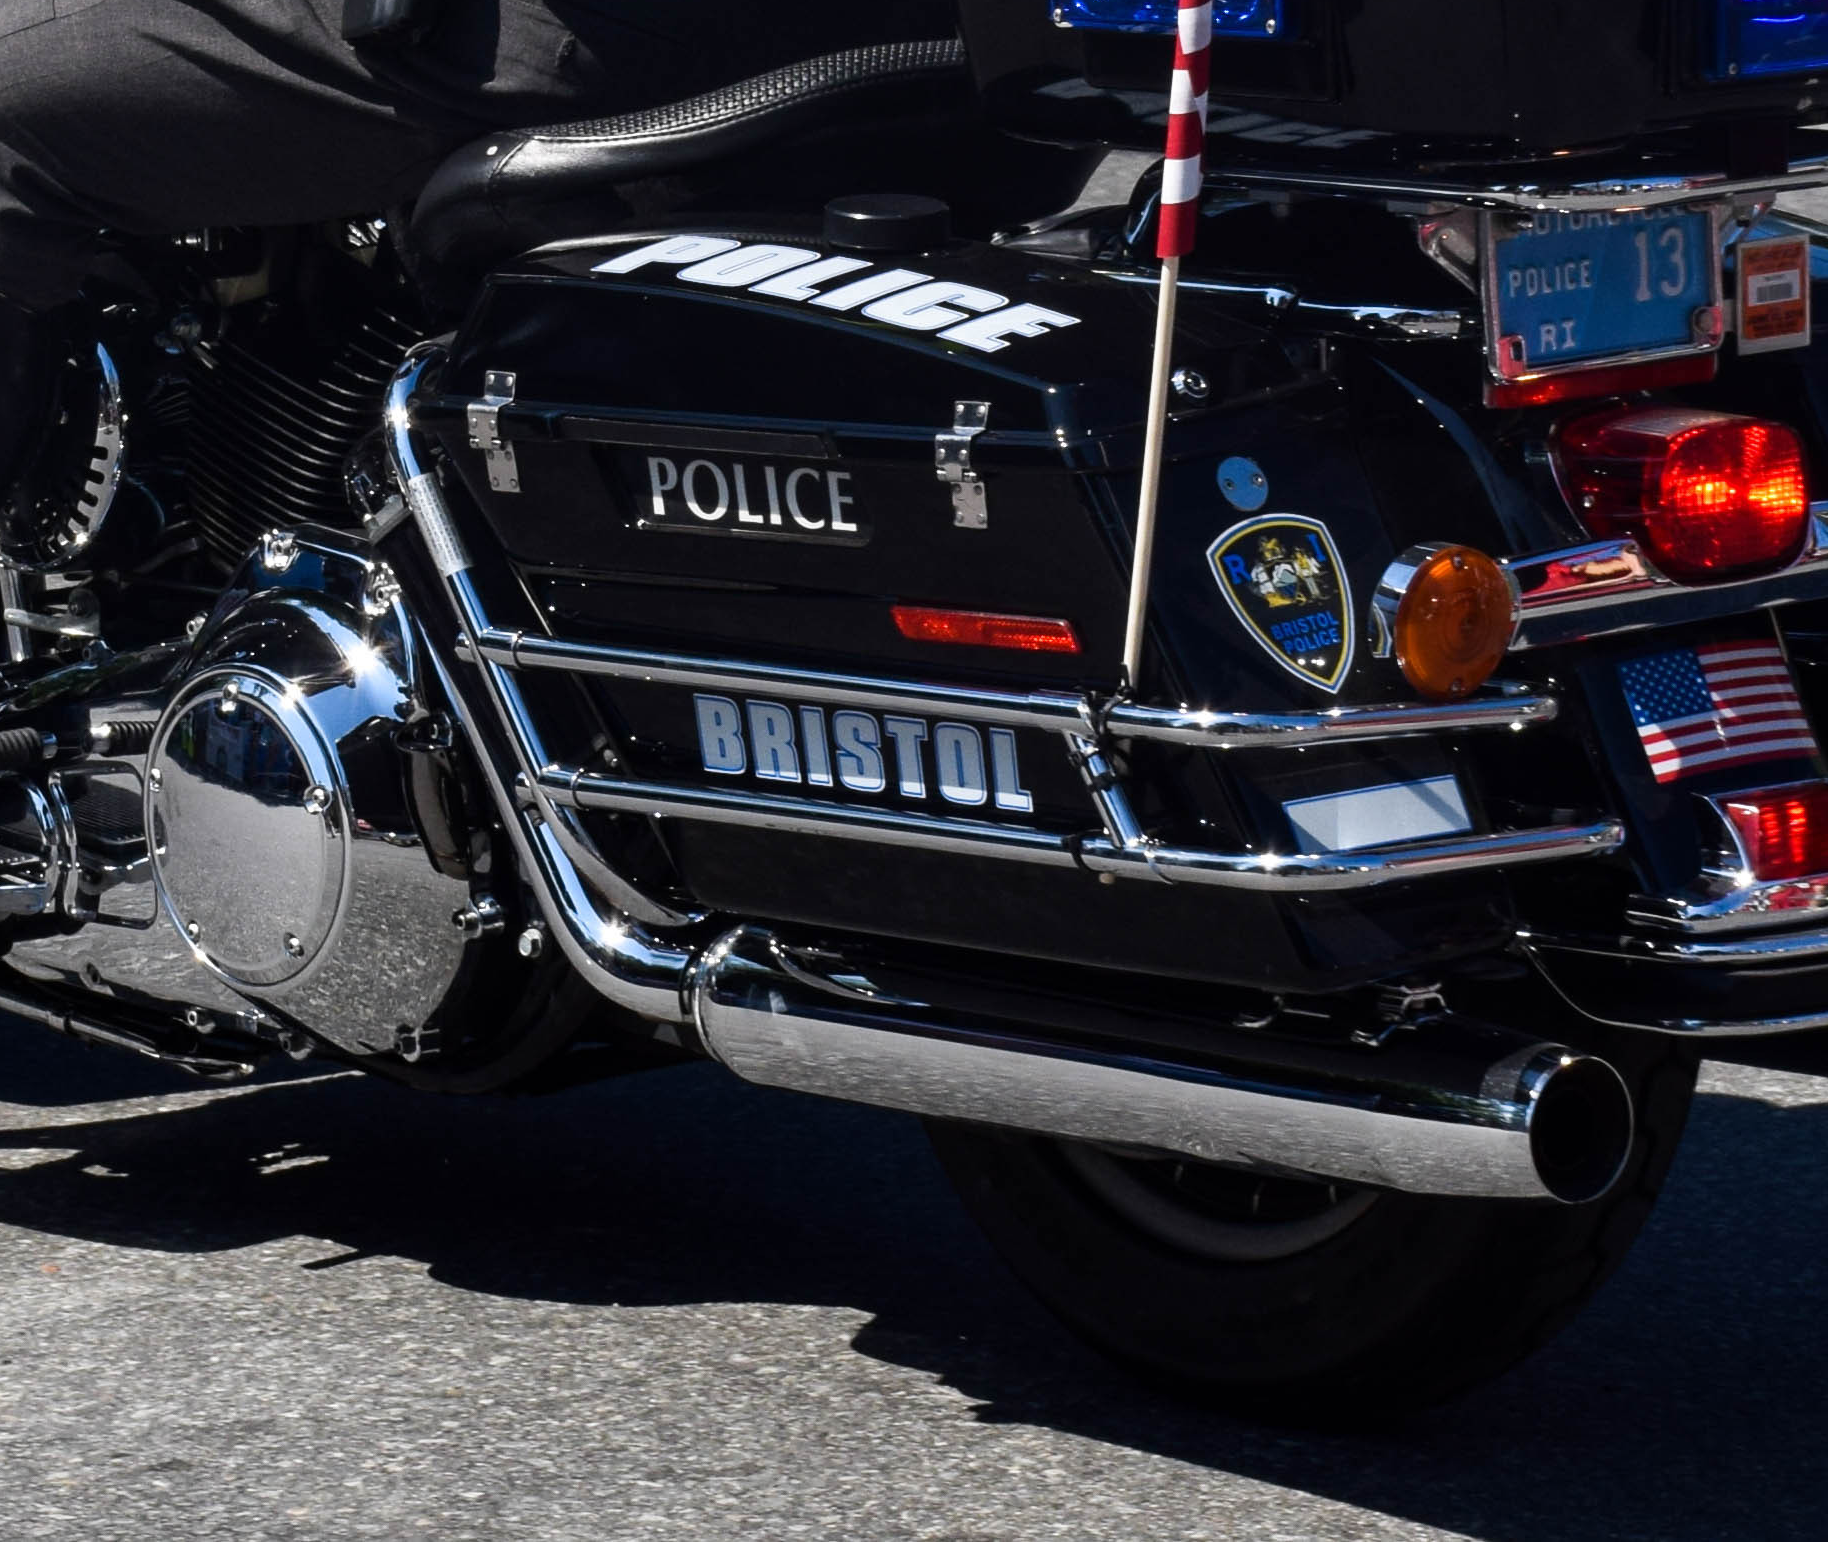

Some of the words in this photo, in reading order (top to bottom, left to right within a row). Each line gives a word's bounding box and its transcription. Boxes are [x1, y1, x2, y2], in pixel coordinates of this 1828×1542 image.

[591, 234, 1082, 354] POLICE
[1508, 258, 1594, 299] POLICE
[1634, 226, 1688, 303] 13
[1540, 317, 1577, 354] RI
[647, 454, 859, 534] POLICE
[1222, 553, 1252, 585] R
[1307, 532, 1327, 562] I
[1269, 609, 1339, 641] BRISTOL
[1281, 627, 1342, 656] POLICE
[692, 692, 1035, 814] BRISTOL
